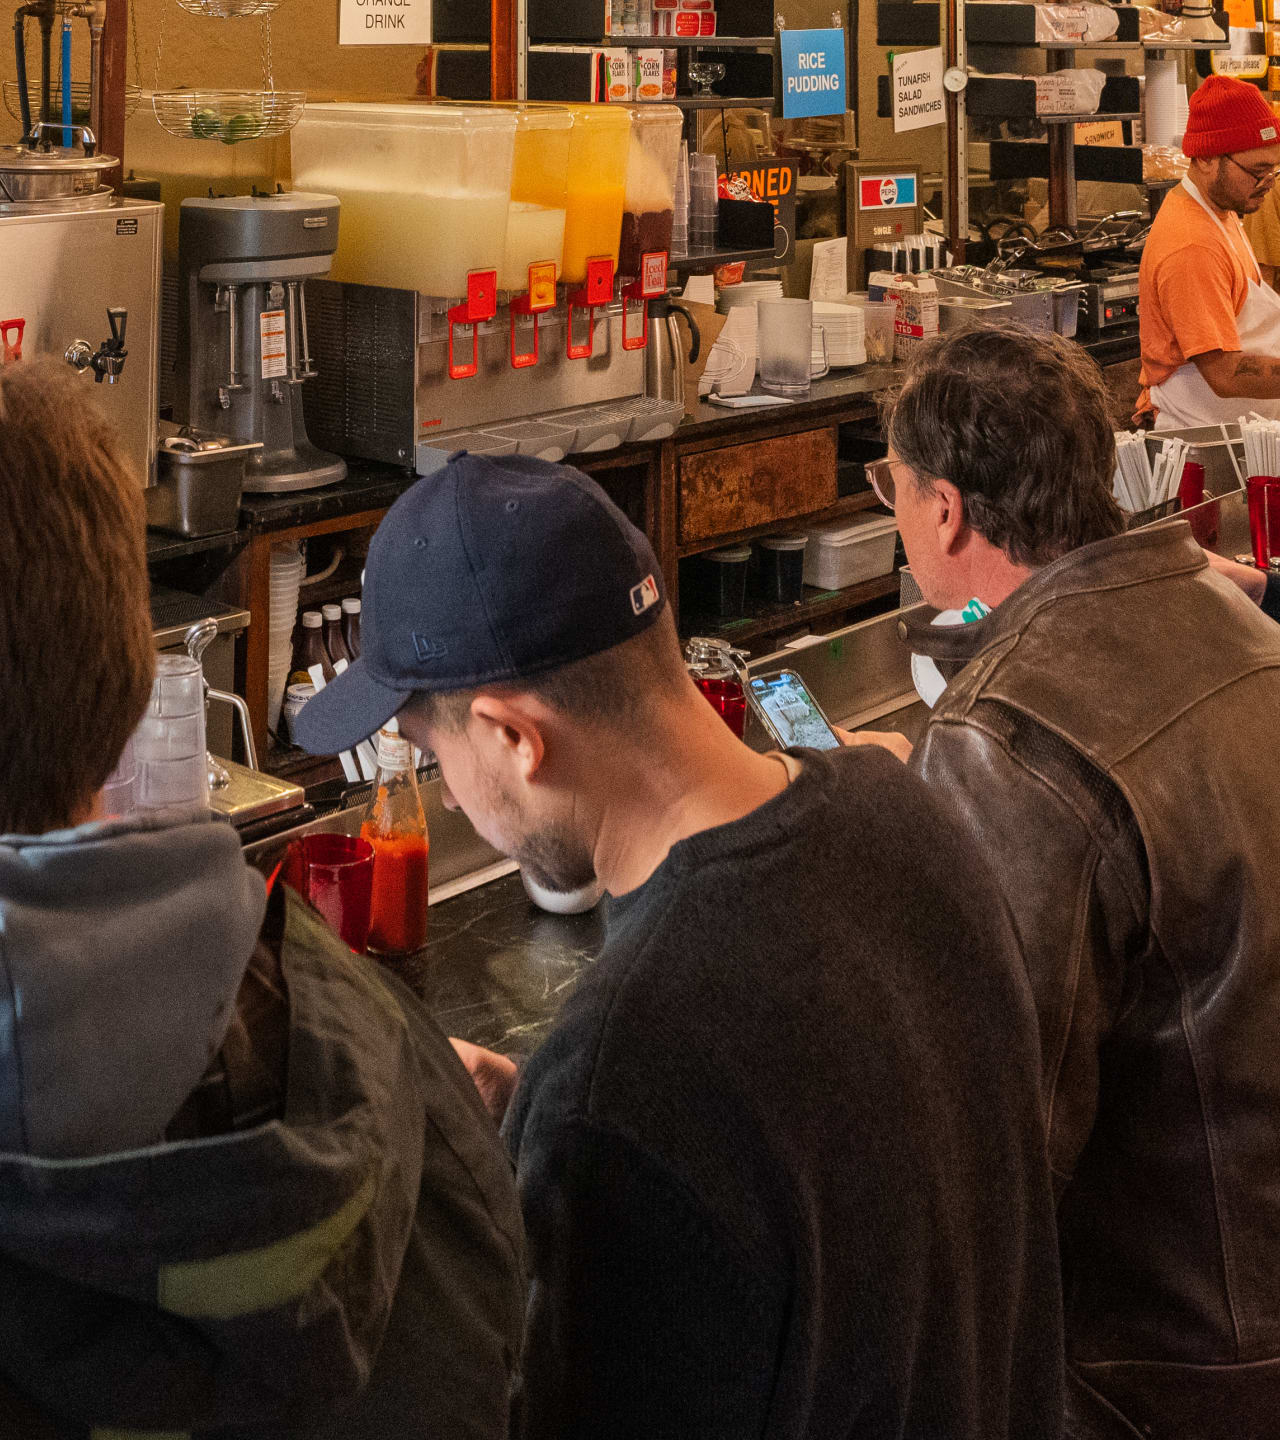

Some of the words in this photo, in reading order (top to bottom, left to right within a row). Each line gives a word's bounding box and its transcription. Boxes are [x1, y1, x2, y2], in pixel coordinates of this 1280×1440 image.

[365, 14, 405, 29] DRINK
[612, 62, 625, 71] CORN
[643, 62, 660, 71] CORN
[798, 52, 826, 69] RICE
[787, 74, 839, 94] PUDDING
[898, 72, 931, 87] TUNAFISH
[898, 89, 922, 103] SALAD
[898, 100, 942, 118] SANDWICHES
[1085, 129, 1115, 145] SANDWICH
[881, 188, 897, 196] PEPSI
[874, 226, 892, 236] SINGLE
[646, 259, 664, 277] Iced
[647, 274, 664, 287] Tea
